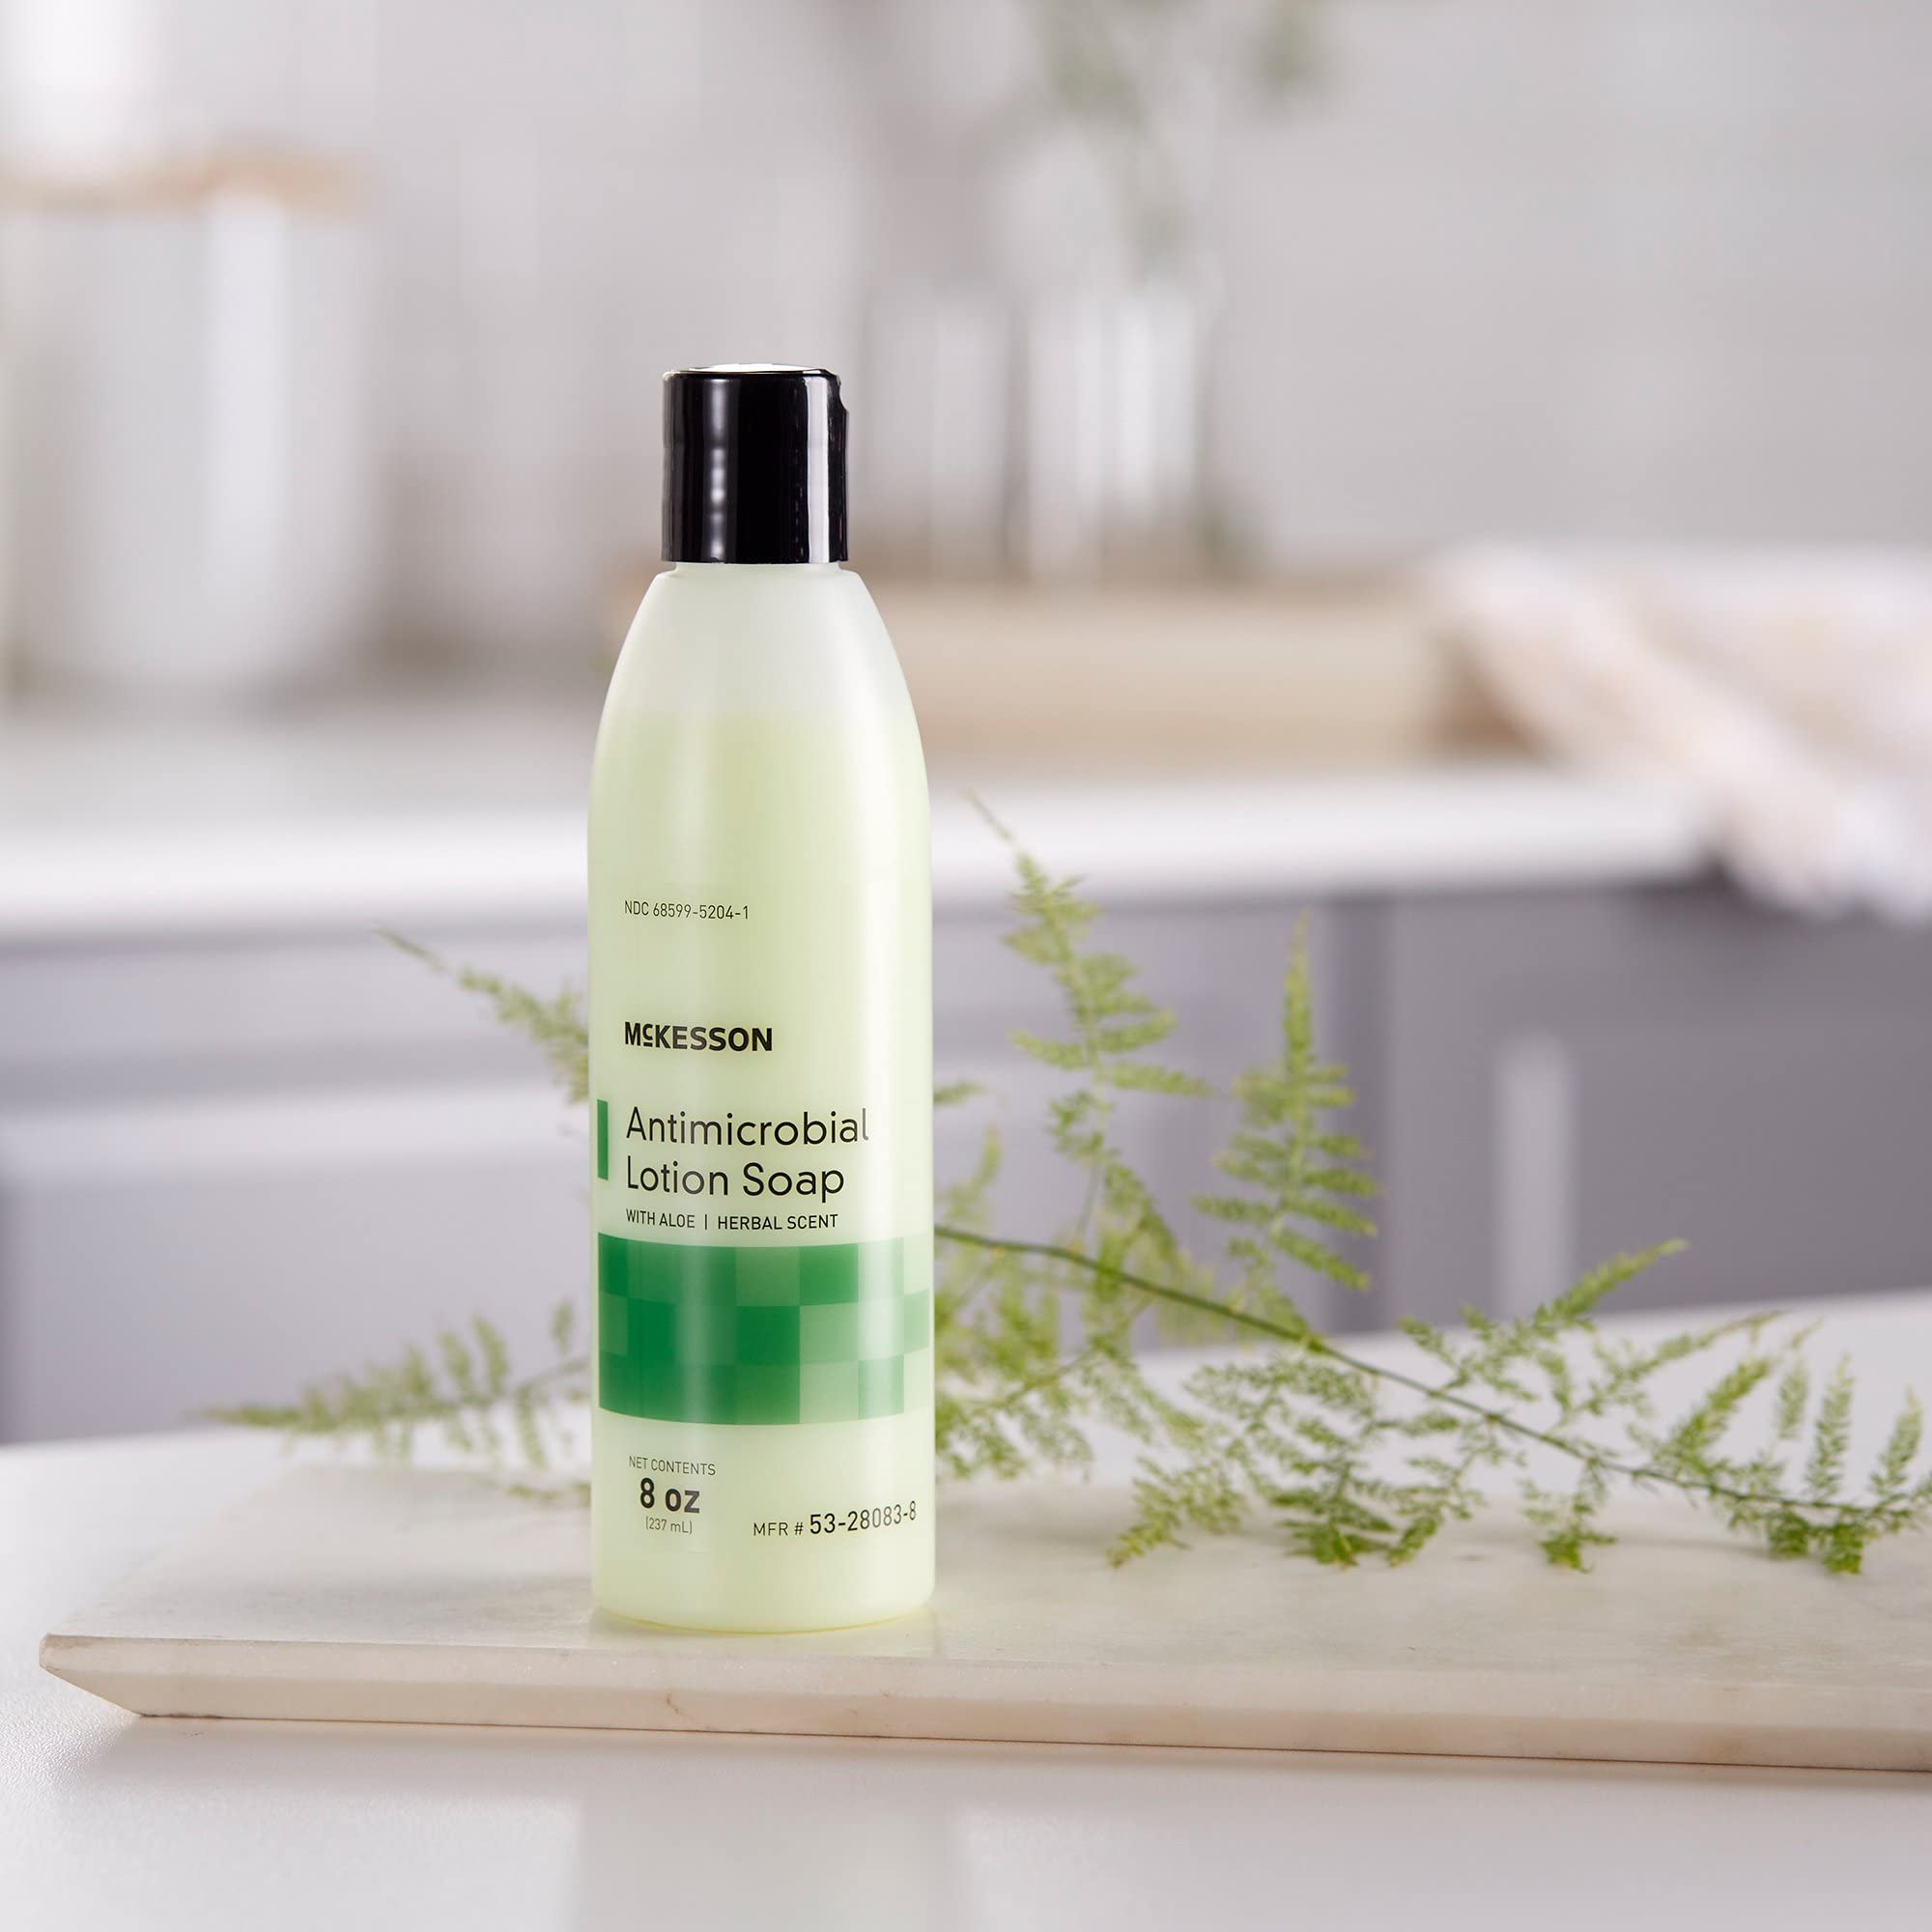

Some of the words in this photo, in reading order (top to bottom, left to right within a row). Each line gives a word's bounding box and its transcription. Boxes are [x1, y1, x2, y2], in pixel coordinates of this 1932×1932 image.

[624, 900, 649, 917] NDC
[653, 902, 750, 920] 68599-5204-1
[626, 1106, 869, 1146] Antimicrobial
[627, 1155, 728, 1196] Lotion
[742, 1162, 844, 1204] Soap
[626, 1208, 655, 1226] WITH
[659, 1213, 695, 1229] ALOE
[717, 1215, 782, 1230] HERBAL
[786, 1214, 838, 1230] SCENT
[629, 1455, 648, 1470] NET
[651, 1459, 716, 1476] CONTENTS
[639, 1477, 655, 1509] 8
[645, 1518, 667, 1532] (237
[670, 1519, 693, 1534] mL)
[753, 1522, 788, 1536] MFR
[794, 1522, 804, 1535] #
[810, 1500, 917, 1534] 53-28083-8
